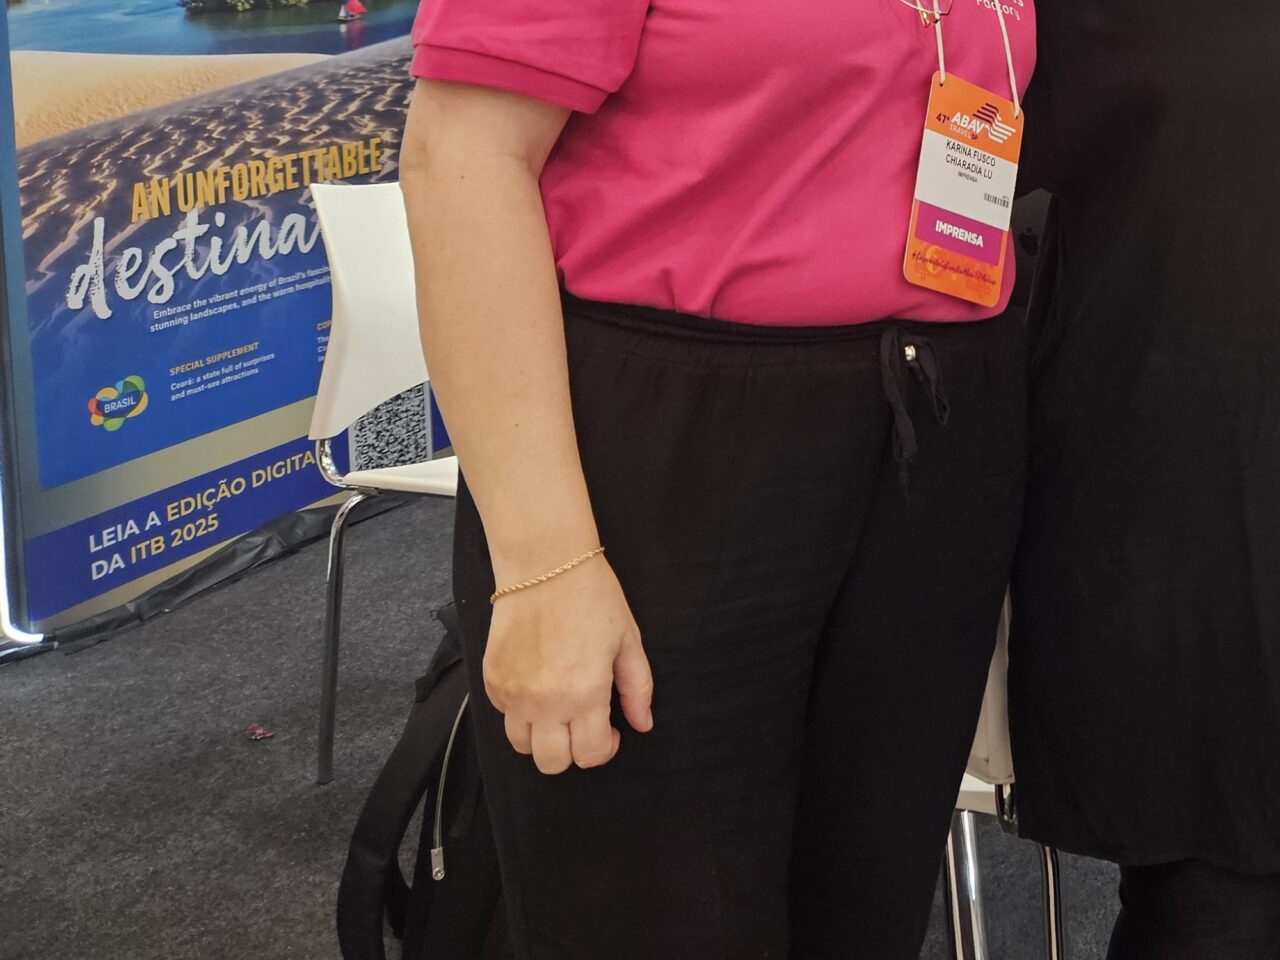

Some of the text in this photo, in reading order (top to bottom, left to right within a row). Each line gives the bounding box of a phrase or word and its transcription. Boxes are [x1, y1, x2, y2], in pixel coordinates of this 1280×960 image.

[951, 111, 985, 134] ABAV
[945, 154, 993, 180] CHIARADIA LU
[946, 140, 996, 167] KARINA FUSCO
[131, 137, 382, 223] AN UNFORGETTABLE
[935, 220, 984, 248] IMPRENSA
[66, 204, 324, 319] destina
[150, 316, 188, 332] stunning
[190, 303, 240, 322] landscapes,
[241, 296, 257, 307] and
[258, 290, 272, 301] the
[273, 286, 295, 298] warm
[153, 303, 191, 320] Embrace
[193, 298, 207, 310] the
[209, 289, 238, 304] vibrant
[239, 284, 267, 298] energy
[269, 278, 277, 288] of
[169, 342, 259, 376] SPECIAL SUPPLEMENT
[170, 378, 195, 390] Ceará:
[202, 369, 220, 380] state
[221, 365, 233, 376] full
[234, 362, 242, 371] of
[243, 353, 275, 369] surprises
[170, 368, 259, 401] and must-see attractions
[104, 396, 136, 413] BRASIL
[88, 451, 316, 553] LEIA A EDIÇÃO DIGITA
[91, 516, 220, 581] DA ITB 2025
